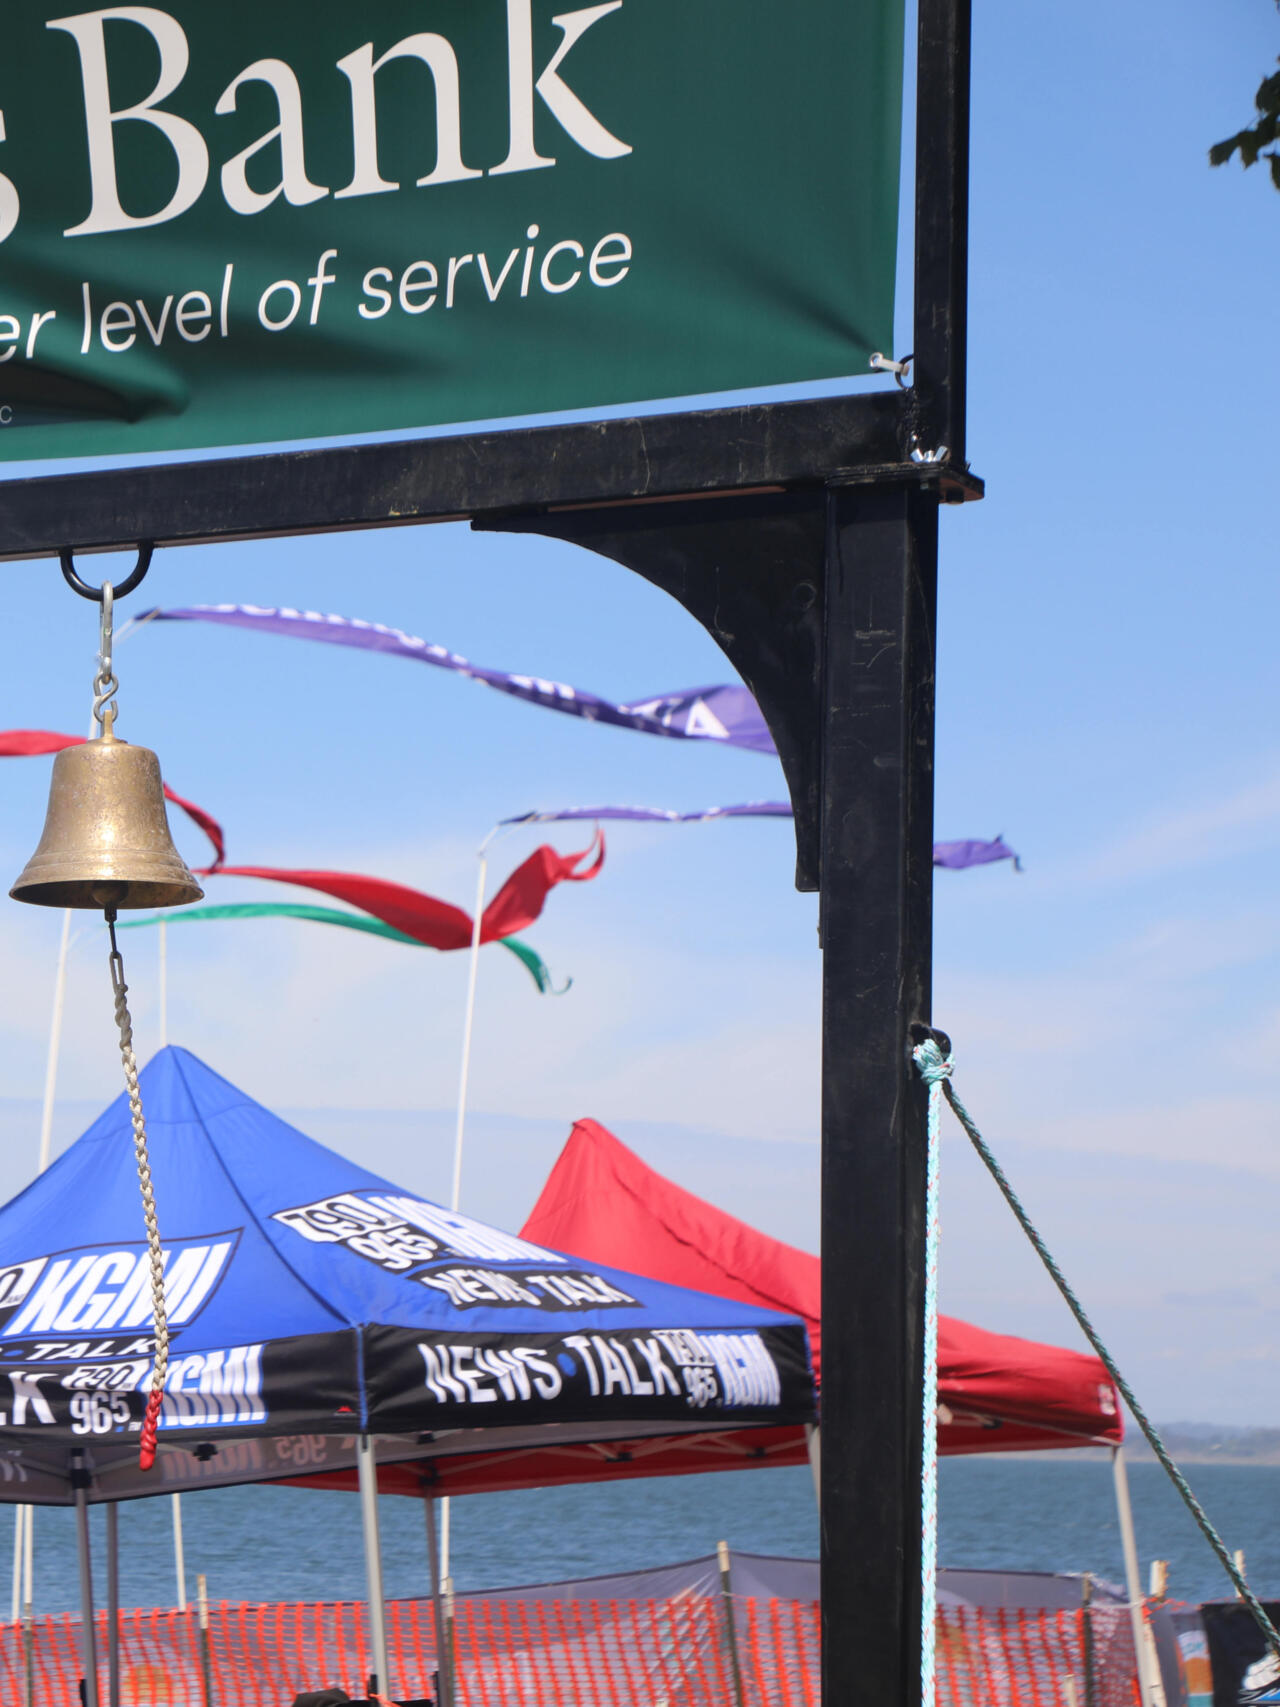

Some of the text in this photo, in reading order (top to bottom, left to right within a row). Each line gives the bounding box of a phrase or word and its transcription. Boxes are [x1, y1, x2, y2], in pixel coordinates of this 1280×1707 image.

[45, 0, 632, 237] Bank
[80, 264, 233, 355] level
[257, 249, 337, 331] of
[357, 223, 632, 320] service
[2, 1241, 232, 1337] KGMI
[25, 1338, 160, 1360] TALK
[70, 1343, 265, 1426] 790 KGMI
[418, 1335, 681, 1403] NEWS TALK
